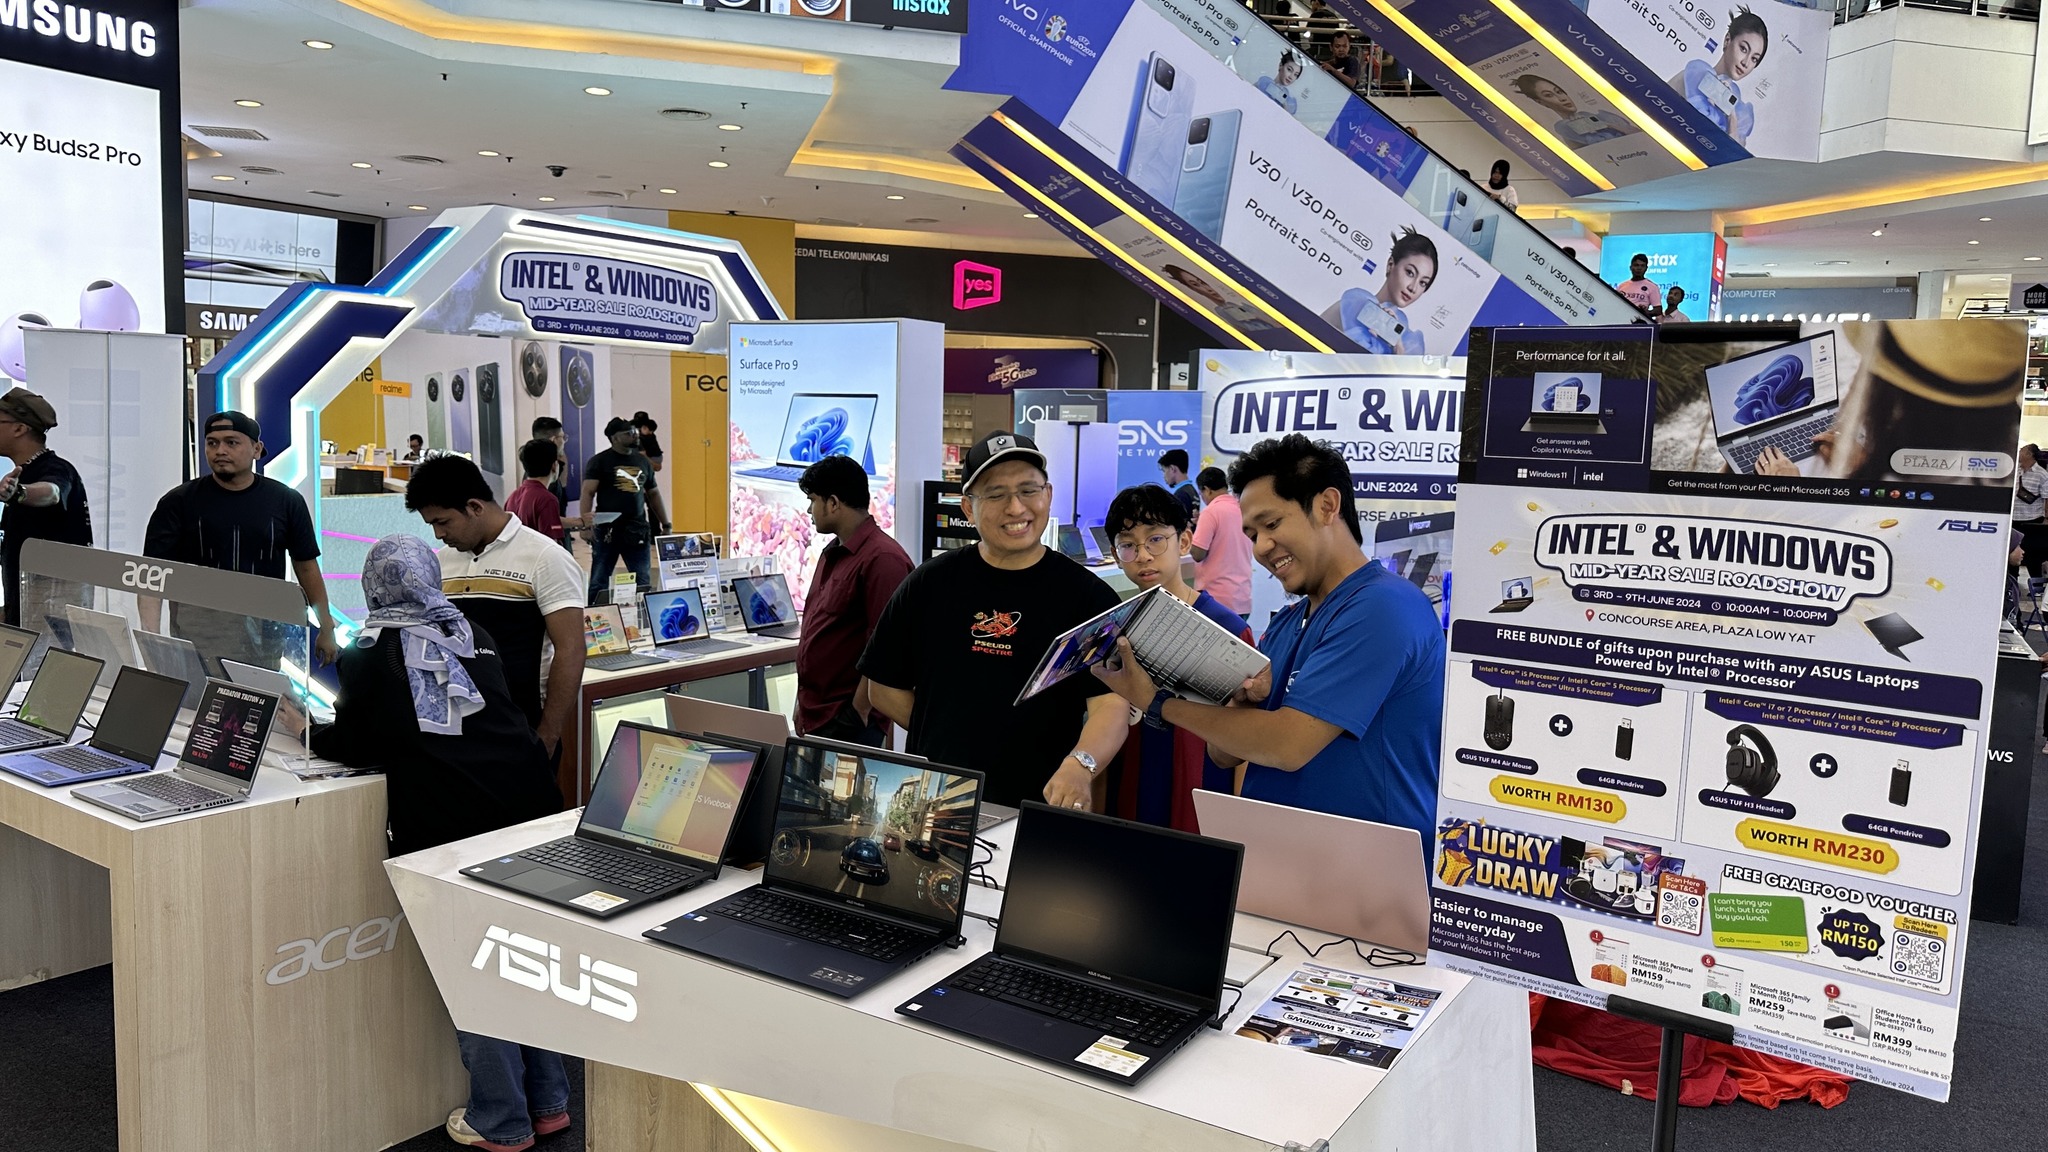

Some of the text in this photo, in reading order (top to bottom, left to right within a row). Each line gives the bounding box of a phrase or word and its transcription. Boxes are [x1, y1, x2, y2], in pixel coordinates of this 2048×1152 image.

[0, 0, 156, 57] MSUNG
[998, 15, 1026, 37] OFFICIAL
[1028, 34, 1074, 66] SMARTPHONE
[1648, 15, 1687, 53] So Pro
[1567, 24, 1696, 135] vivo V30 V30 Pro
[1435, 73, 1497, 123] vivo V30
[1348, 121, 1373, 145] vivo
[33, 133, 100, 160] Buds2
[106, 145, 142, 167] Pro
[1248, 150, 1371, 250] V30 V30 Pro 5G
[1102, 170, 1254, 283] vivo V30 V30 Pro
[1245, 198, 1343, 277] Portrait So Pro
[288, 243, 320, 258] here
[818, 249, 889, 262] TELEKOMUNIKASI
[965, 277, 993, 294] yes
[1527, 248, 1581, 294] V30 V30 Pro
[584, 264, 604, 295] &
[606, 266, 710, 312] WINDOWS
[1525, 274, 1578, 317] Portrait So Pro
[1722, 289, 1776, 299] KOMPUTER
[529, 296, 698, 328] MID-YEAR SALE ROADSHOW
[547, 321, 689, 343] 3RD 9TH JUNE 2024 10:00AM 10:00PM
[748, 338, 793, 346] Microsoft Surface
[740, 358, 799, 370] Surface Pro 9
[1516, 350, 1626, 361] Performance for it all.
[740, 379, 785, 388] Laptops designed
[1359, 388, 1394, 433] &
[1118, 420, 1189, 446] SNS
[1378, 441, 1433, 462] SALE
[1967, 457, 1998, 469] SNS
[1353, 481, 1418, 493] JUNE 2024
[1529, 470, 1560, 479] Windows
[1583, 472, 1603, 481] intel
[1667, 479, 1850, 497] Get the most from your PC with Microsoft 365
[1937, 519, 1998, 534] ASUS
[1652, 525, 1682, 560] &
[1688, 526, 1875, 581] WINDOWS
[122, 561, 173, 592] acer
[1570, 562, 1846, 602] MID-YEAR SALE ROADSHOW
[1593, 590, 1827, 622] 3RD 9TH JUNE 2024 10:00AM 10:00PM
[1598, 612, 1816, 644] CONCOURSE AREA, PLAZA LOW YAT
[1496, 628, 1920, 691] FREE BUNDLE of gifts upon purchase with any ASUS Laptops
[1595, 654, 1652, 671] Powered
[1656, 661, 1674, 675] by
[1726, 671, 1796, 689] Processor
[1502, 783, 1613, 814] WORTH RM130
[1467, 824, 1554, 866] LUCKY
[1750, 827, 1885, 865] WORTH RM230
[1475, 856, 1560, 899] DRAW
[1724, 864, 1957, 925] FREE GRABFOOD VOUCHER
[1433, 897, 1544, 932] Easier to manage
[1433, 912, 1516, 943] the everyday
[1833, 918, 1869, 934] UP TO
[265, 911, 407, 986] acer
[1432, 927, 1541, 960] Microsoft 365 has the best apps
[1432, 935, 1512, 961] for your Windows 11 PC.
[1822, 928, 1878, 952] RM150
[471, 924, 638, 1023] ASUS
[1631, 968, 1663, 982] RM159
[1749, 996, 1785, 1012] RM259
[1873, 1030, 1912, 1048] RM399
